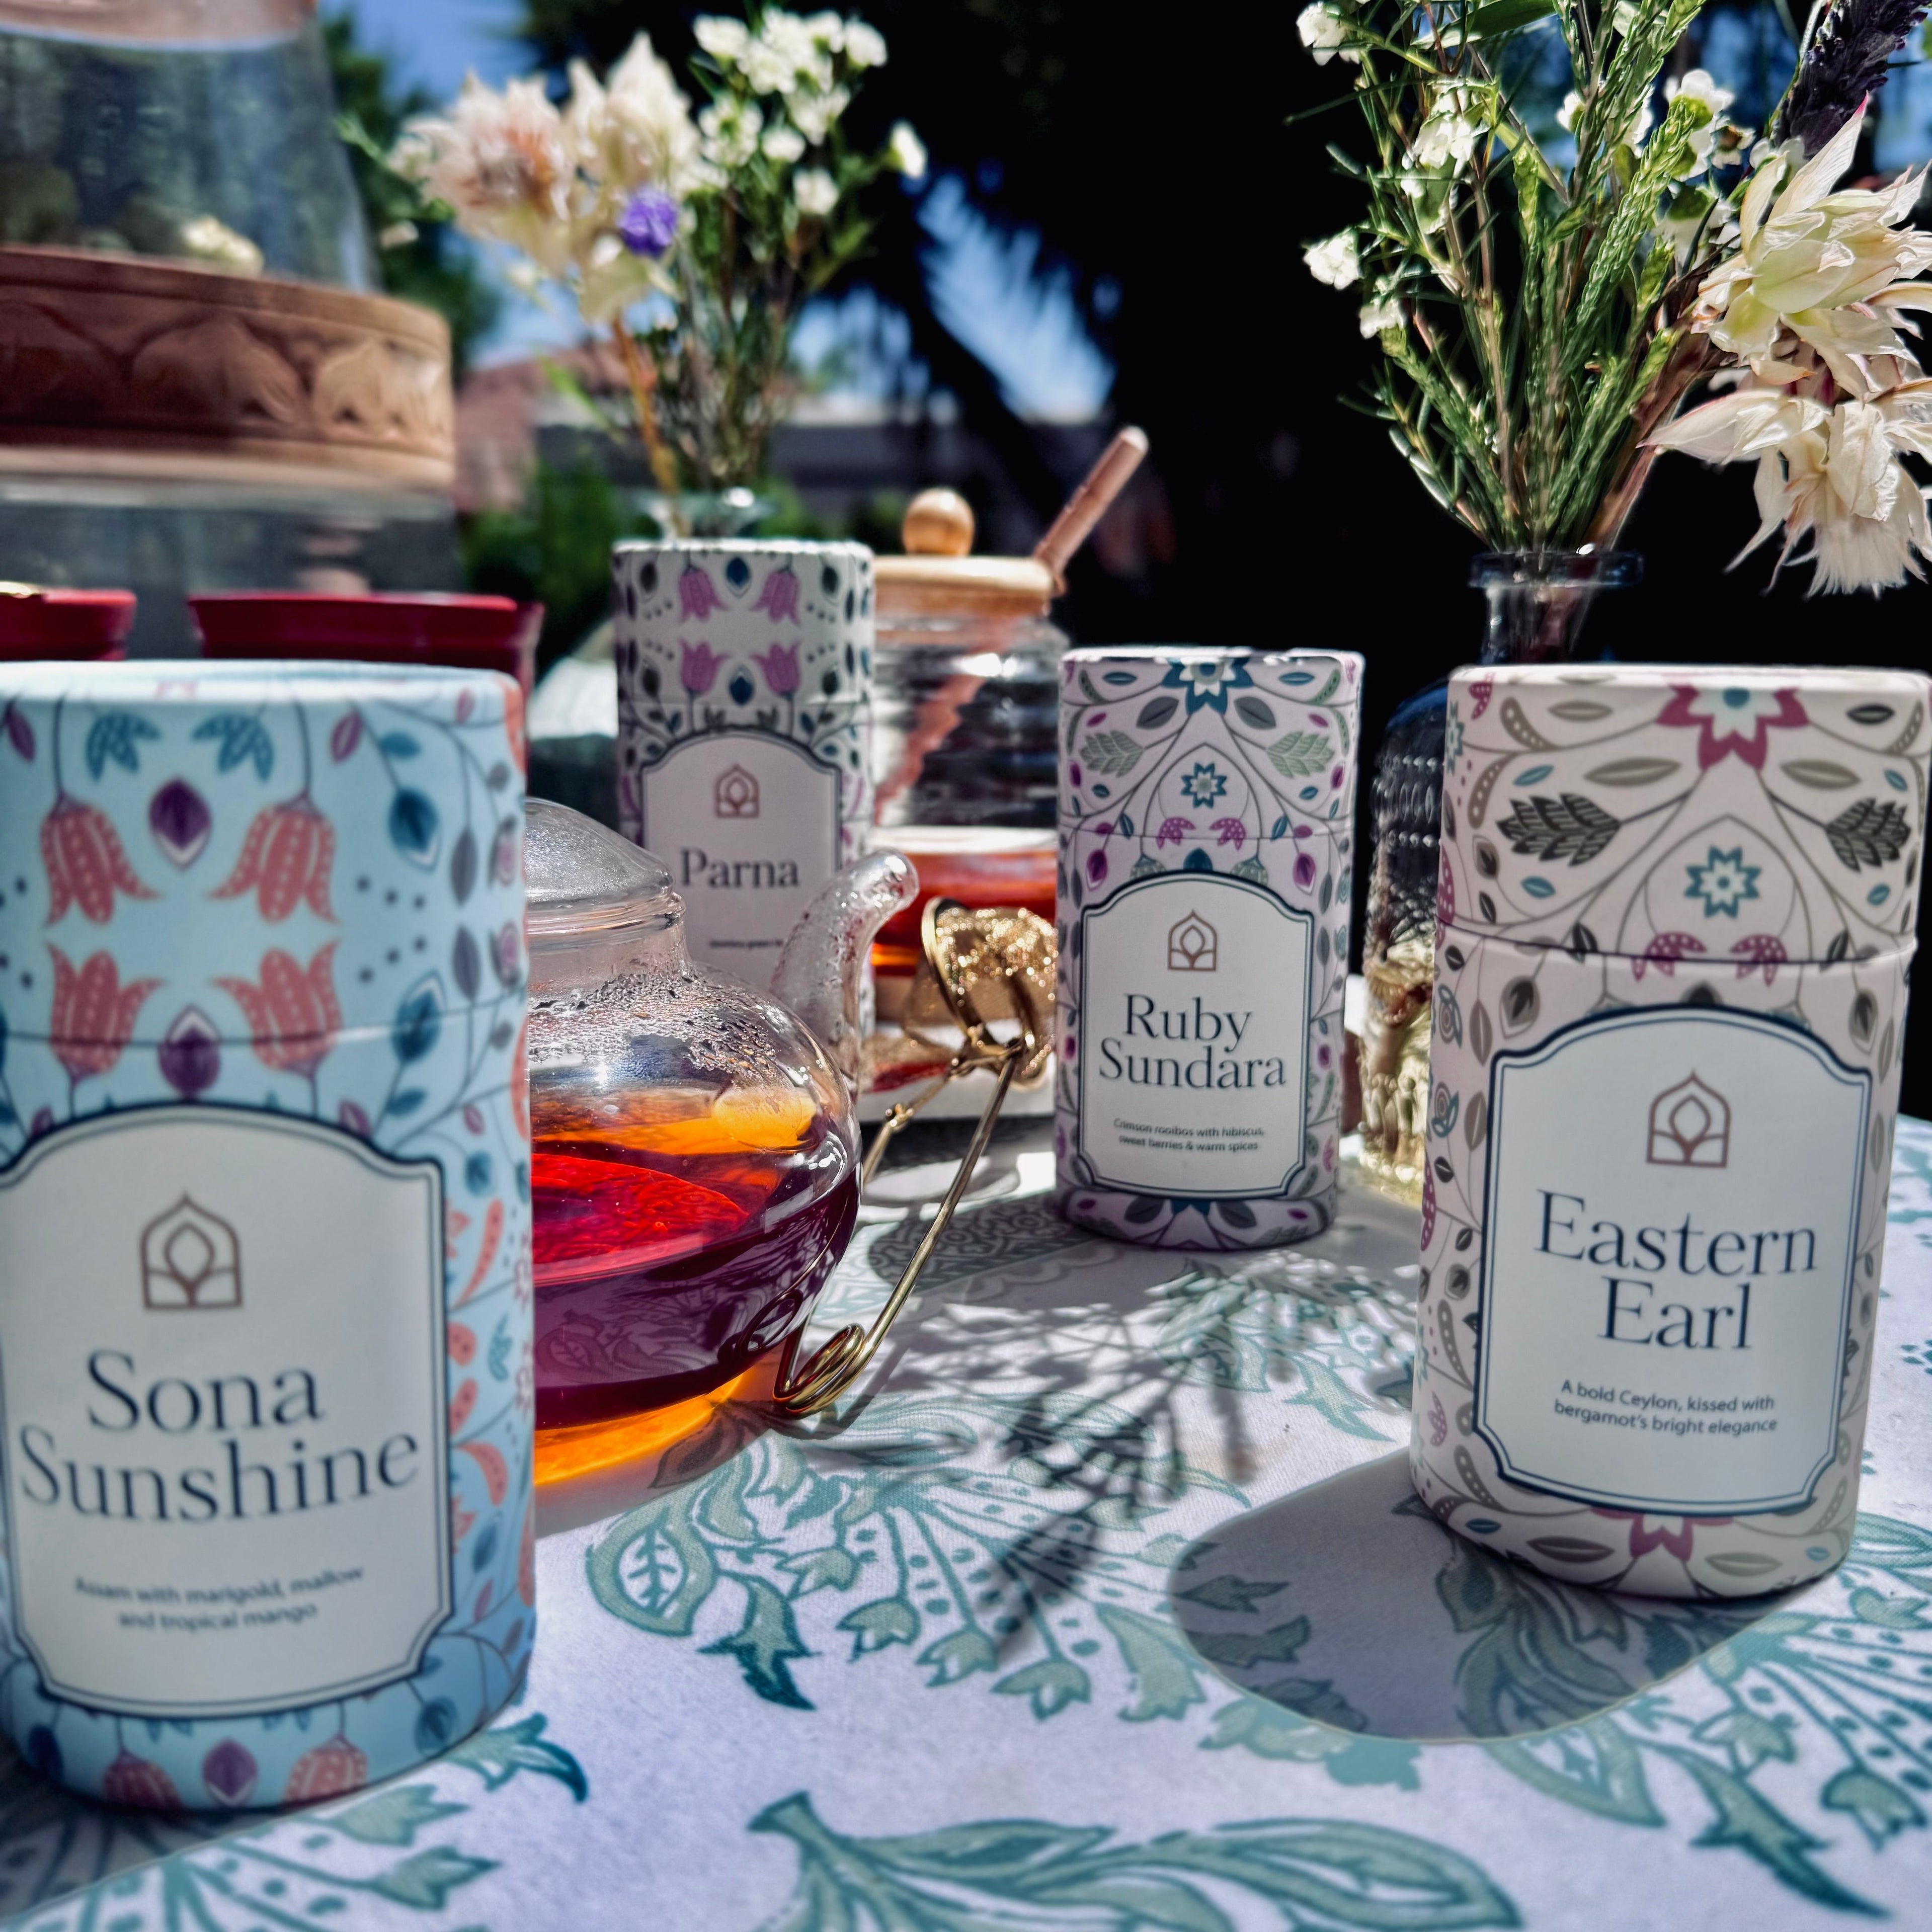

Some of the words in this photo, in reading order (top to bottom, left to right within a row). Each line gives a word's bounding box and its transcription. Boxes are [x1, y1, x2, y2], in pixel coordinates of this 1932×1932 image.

[681, 847, 800, 889] Parna
[1123, 993, 1253, 1053] Ruby
[1099, 1037, 1286, 1089] Sundara
[1113, 1117, 1152, 1134] Crimson
[1154, 1125, 1193, 1136] rooibos
[1196, 1127, 1219, 1137] with
[1148, 1138, 1183, 1150] berries
[1185, 1140, 1193, 1151] &
[1196, 1142, 1225, 1151] warm
[1228, 1141, 1258, 1153] spices
[1534, 1188, 1819, 1277] Eastern
[1597, 1274, 1752, 1350] Earl
[87, 1348, 326, 1435] Sona
[1561, 1380, 1573, 1394] A
[1577, 1382, 1615, 1402] bold
[1619, 1390, 1682, 1412] Ceylon,
[1687, 1395, 1738, 1412] kissed
[1741, 1395, 1775, 1410] with
[1555, 1398, 1648, 1429] bergamot's
[1651, 1415, 1704, 1437] bright
[1708, 1418, 1778, 1437] elegance
[19, 1423, 421, 1523] Sunshine
[136, 1585, 181, 1602] with
[185, 1579, 286, 1605] marigold,
[290, 1567, 363, 1593] mallow
[120, 1612, 155, 1629] and
[160, 1611, 238, 1634] tropical
[243, 1603, 318, 1626] mango
